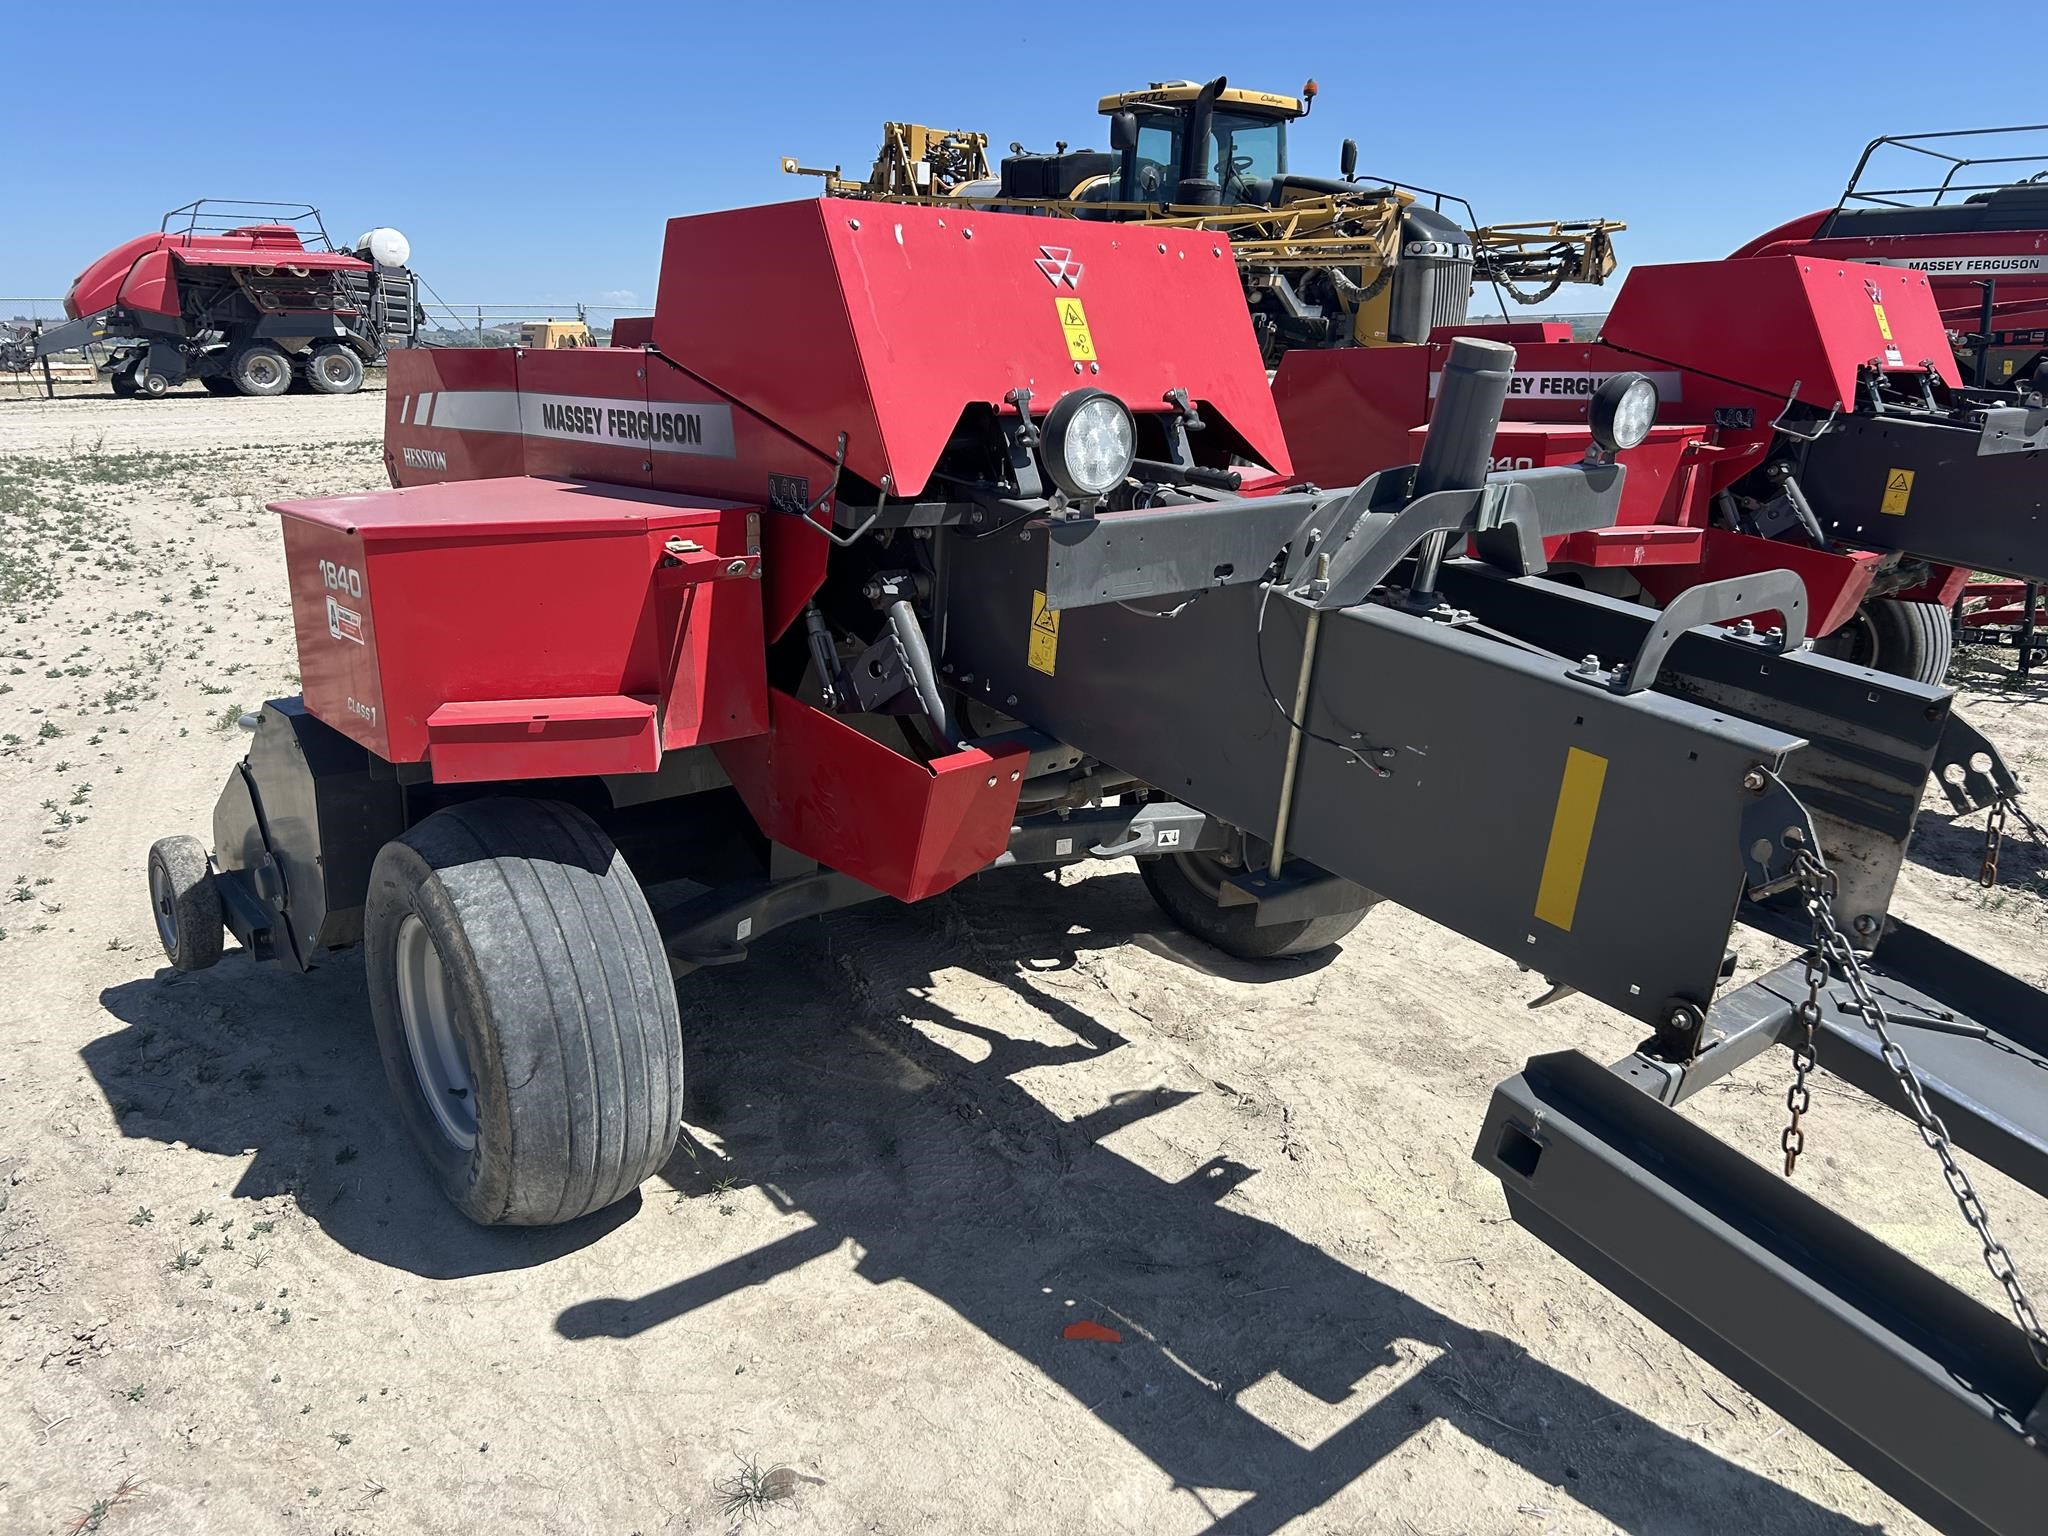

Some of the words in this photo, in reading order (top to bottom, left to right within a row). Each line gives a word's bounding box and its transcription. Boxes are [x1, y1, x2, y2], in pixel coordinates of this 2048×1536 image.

[1908, 260, 1964, 271] MASSEY
[1966, 259, 2040, 270] FERGUSON
[1540, 377, 1609, 395] FERGU
[542, 402, 602, 435] MASSEY
[607, 408, 702, 445] FERGUSON
[402, 447, 447, 471] HESSTON
[318, 559, 362, 599] 1840
